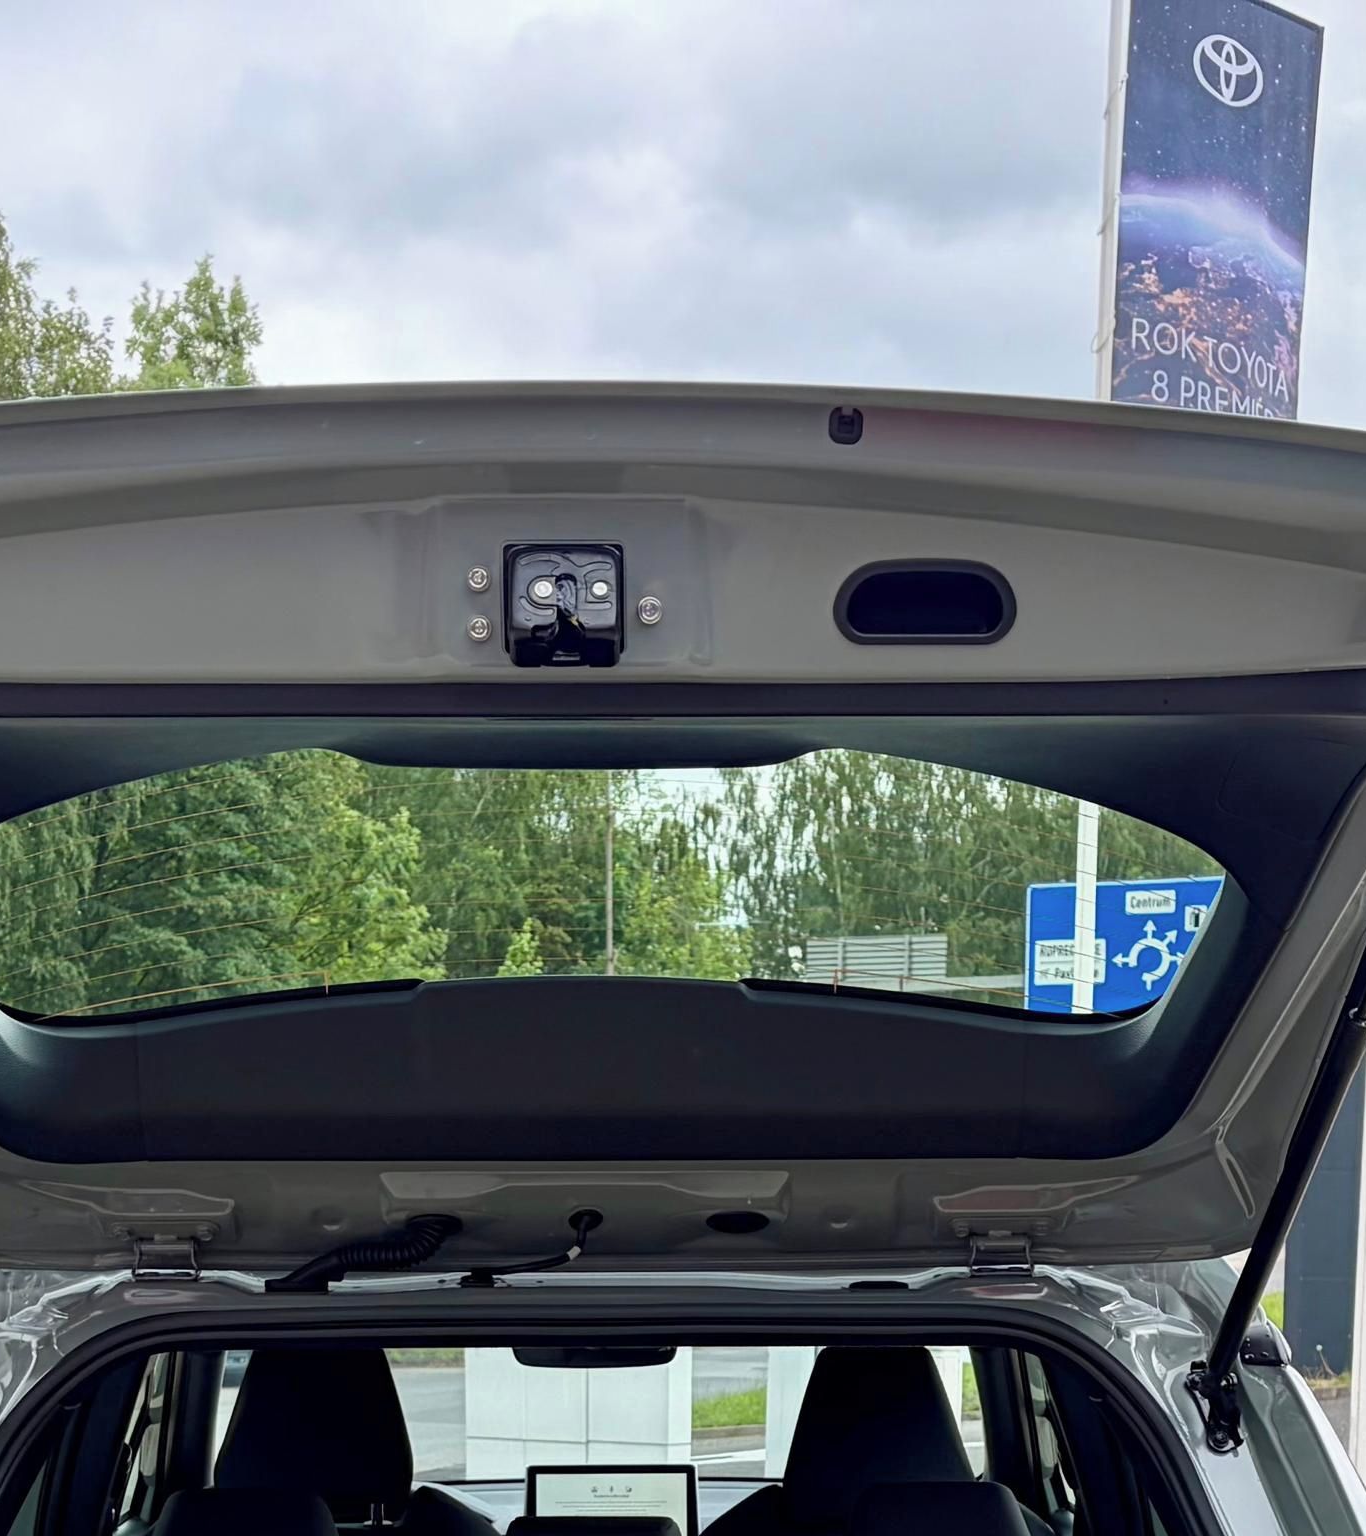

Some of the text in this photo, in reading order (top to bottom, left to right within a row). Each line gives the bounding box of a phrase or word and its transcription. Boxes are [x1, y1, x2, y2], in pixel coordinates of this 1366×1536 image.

[1131, 318, 1289, 402] ROK TOYOTA
[1151, 370, 1169, 402] 8
[1130, 896, 1171, 909] Centrum
